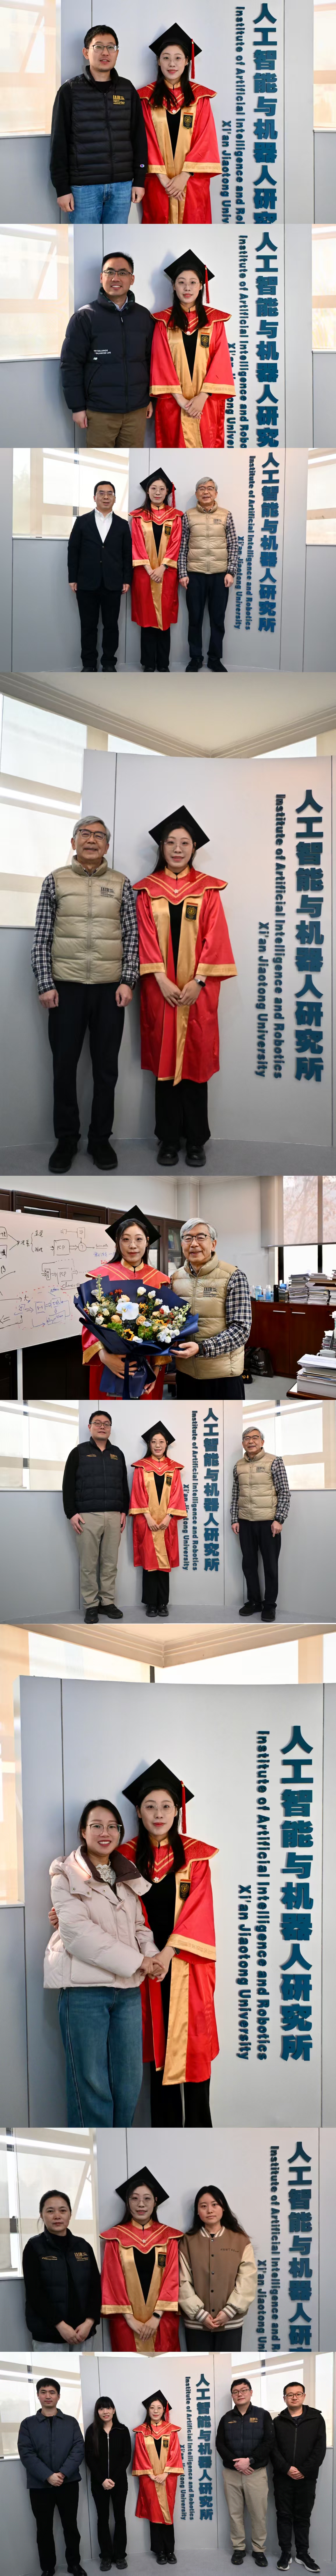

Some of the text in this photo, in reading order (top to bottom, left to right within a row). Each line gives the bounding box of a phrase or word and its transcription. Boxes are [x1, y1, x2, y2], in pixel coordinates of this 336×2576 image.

[236, 7, 245, 52] Institute
[236, 56, 245, 65] of
[236, 68, 245, 115] Artificial
[222, 120, 231, 147] Xi'an
[234, 119, 245, 182] Intelligence
[220, 150, 231, 197] Jiaotong
[236, 186, 245, 204] and
[238, 236, 249, 448] Institute of Artificial Intelligence and Robo
[255, 232, 279, 447] 人工智能与机器人研究
[246, 535, 254, 580] Intelligence
[258, 453, 279, 633] 人工智能与机器人研究所
[234, 557, 243, 589] Jiaotong
[234, 591, 243, 629] University
[273, 794, 286, 1079] Institute of Artificial Intelligence and Robotics
[294, 790, 324, 1082] 人工智能与机器人研究所
[255, 922, 269, 1077] Xi'an Jiaotong University
[204, 1408, 219, 1571] 人工智能与机器人研究所
[255, 1731, 270, 2060] Institute of Artificial Intelligence and Robotics
[280, 1726, 313, 2061] 人工智能与机器人研究所
[237, 1885, 251, 2060] Xi'an Jiaotong University
[271, 2146, 279, 2192] Institute
[271, 2195, 280, 2205] of
[271, 2208, 280, 2254] Artificial
[288, 2142, 312, 2352] 人工智能与机器人研
[258, 2260, 266, 2285] Xi'an
[269, 2258, 280, 2320] Intelligence
[256, 2289, 267, 2333] Jiaotong
[271, 2323, 280, 2341] and
[196, 2374, 213, 2520] 人工智能与机器人研究所
